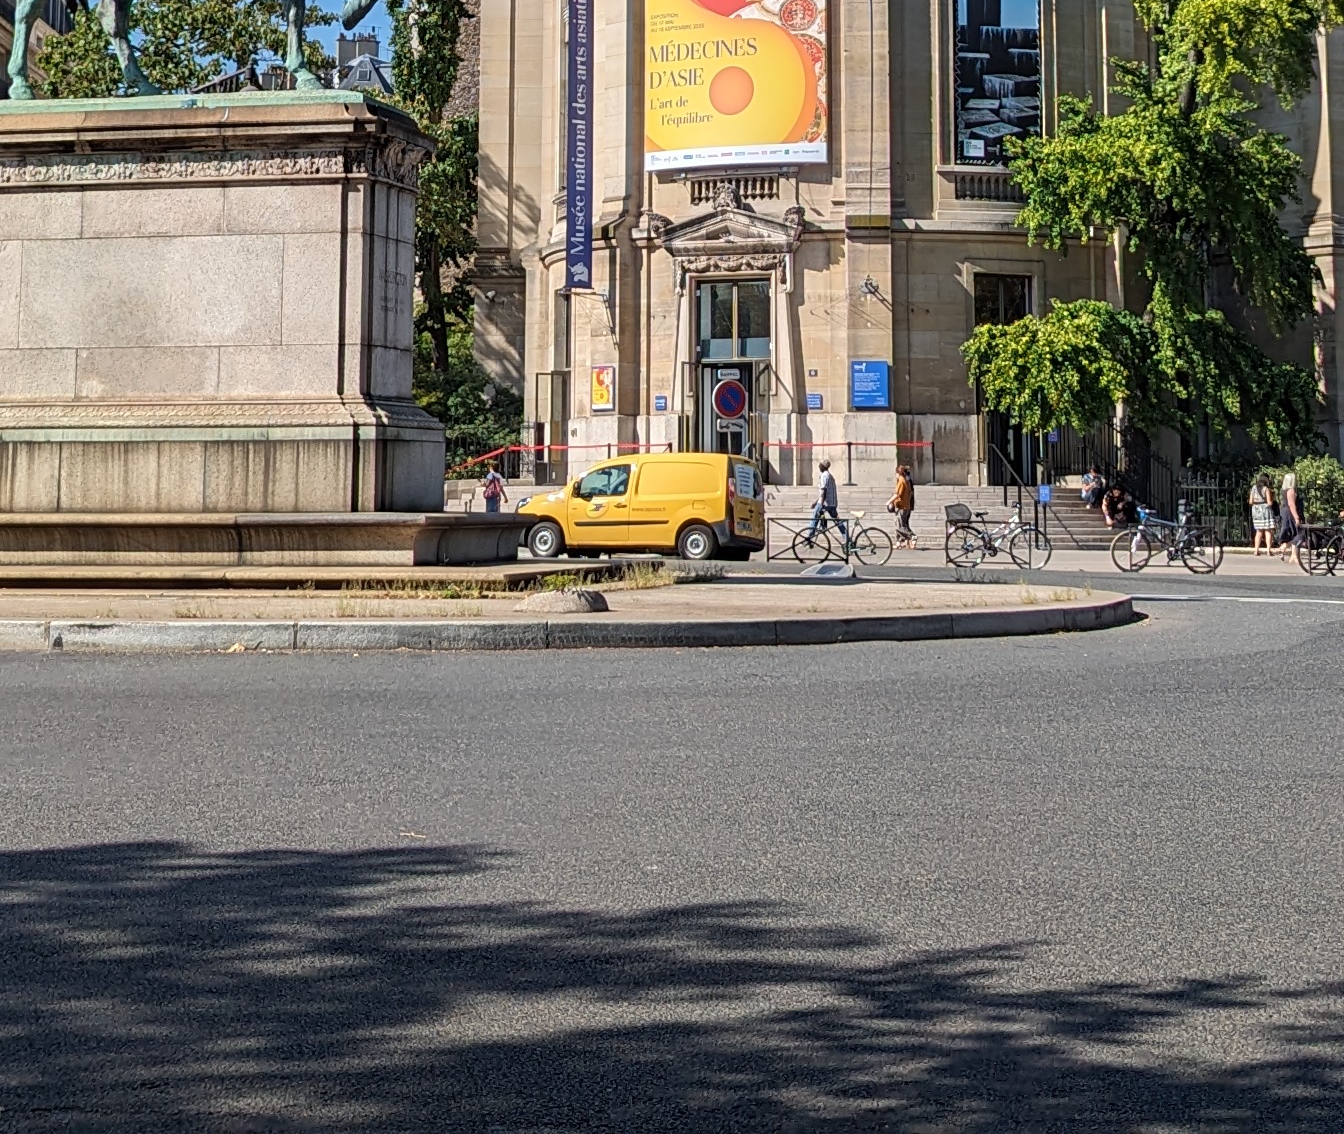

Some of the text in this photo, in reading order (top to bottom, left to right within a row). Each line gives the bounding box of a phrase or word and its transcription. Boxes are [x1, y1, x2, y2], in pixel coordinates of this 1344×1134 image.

[574, 46, 587, 81] arts
[649, 37, 758, 64] MÉDECINES
[649, 67, 705, 90] D'ASIE
[571, 85, 587, 115] des
[650, 95, 689, 110] L'art de
[661, 112, 714, 128] l'équilibre
[571, 119, 587, 191] national
[570, 194, 586, 256] Musée
